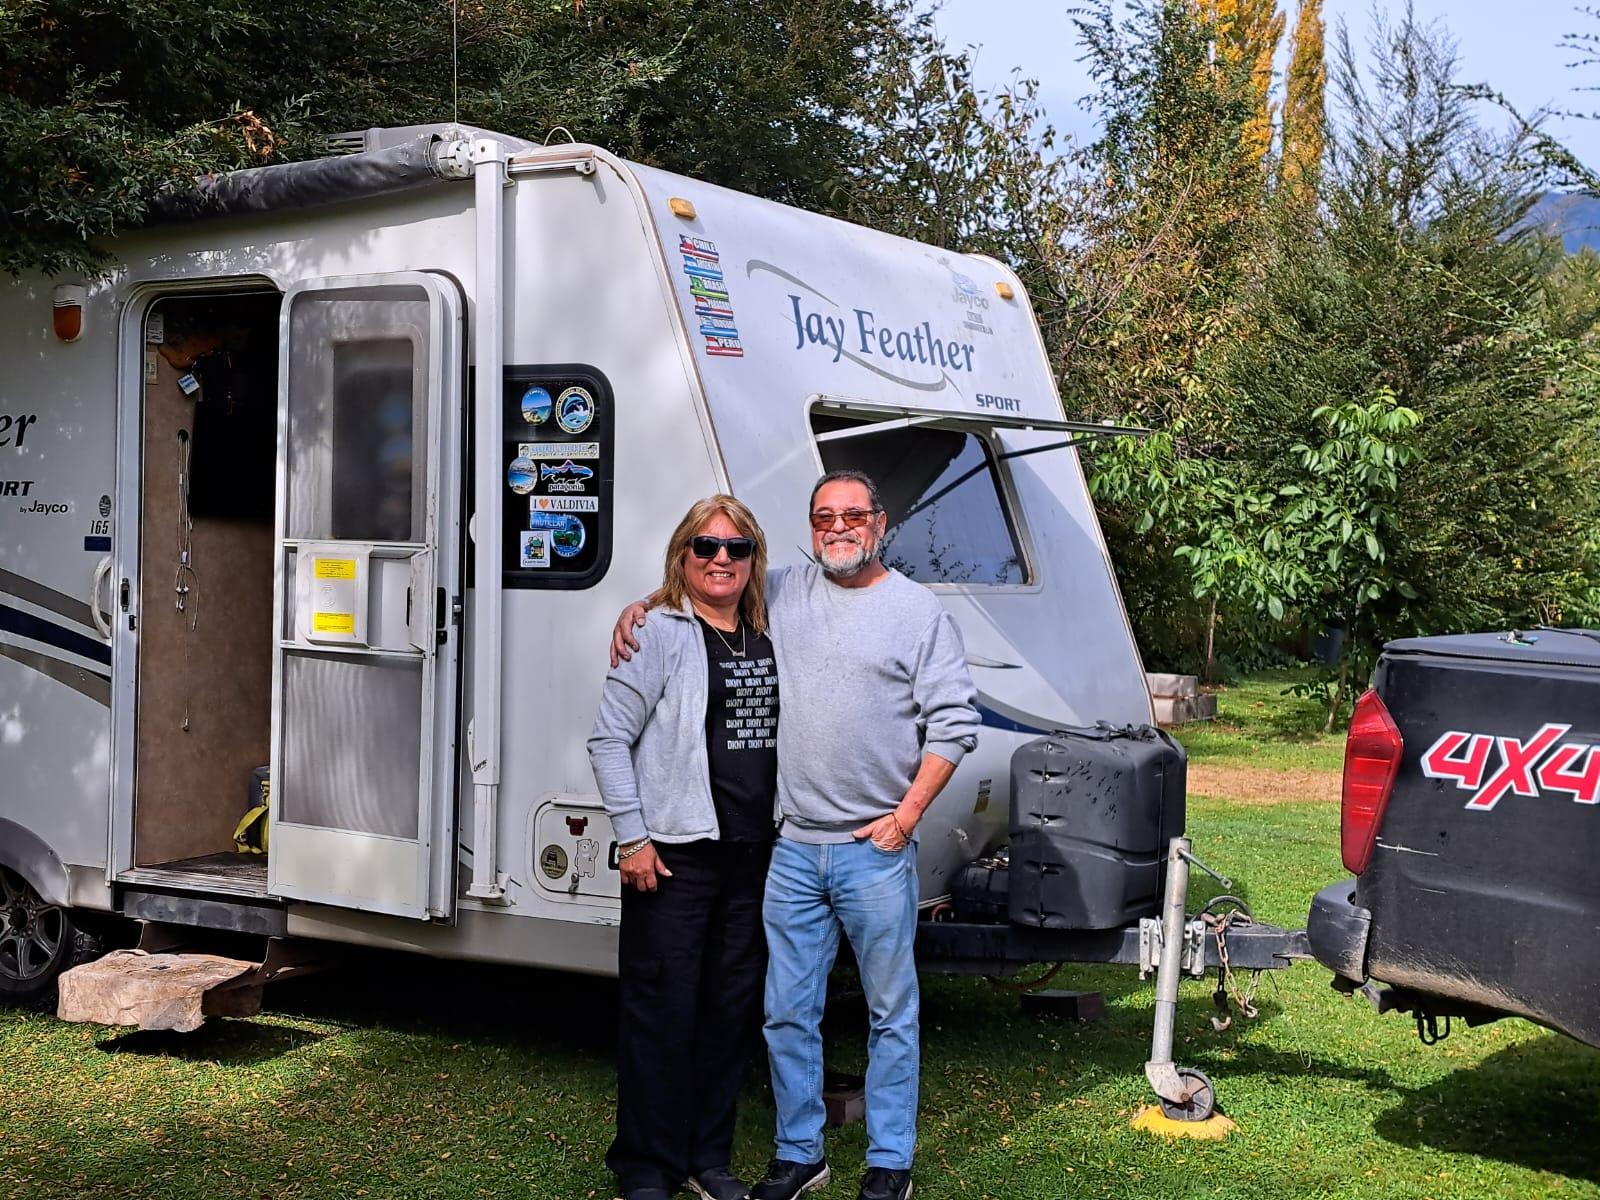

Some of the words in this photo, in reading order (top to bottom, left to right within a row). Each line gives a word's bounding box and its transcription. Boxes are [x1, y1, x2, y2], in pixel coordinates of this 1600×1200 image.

[692, 238, 717, 251] CHILE
[952, 286, 990, 310] Jayco
[788, 294, 845, 363] Jay
[853, 308, 975, 372] Feather
[976, 394, 1021, 412] SPORT
[0, 481, 34, 496] RT
[548, 483, 585, 492] patagonia
[28, 500, 68, 515] Jayco
[551, 499, 596, 510] VALDIVIA
[91, 520, 110, 534] 165
[736, 688, 754, 697] DKNY
[756, 686, 773, 696] DKNY
[726, 719, 744, 729] DKNY
[737, 729, 754, 738] DKNY
[727, 740, 745, 750] DKNY
